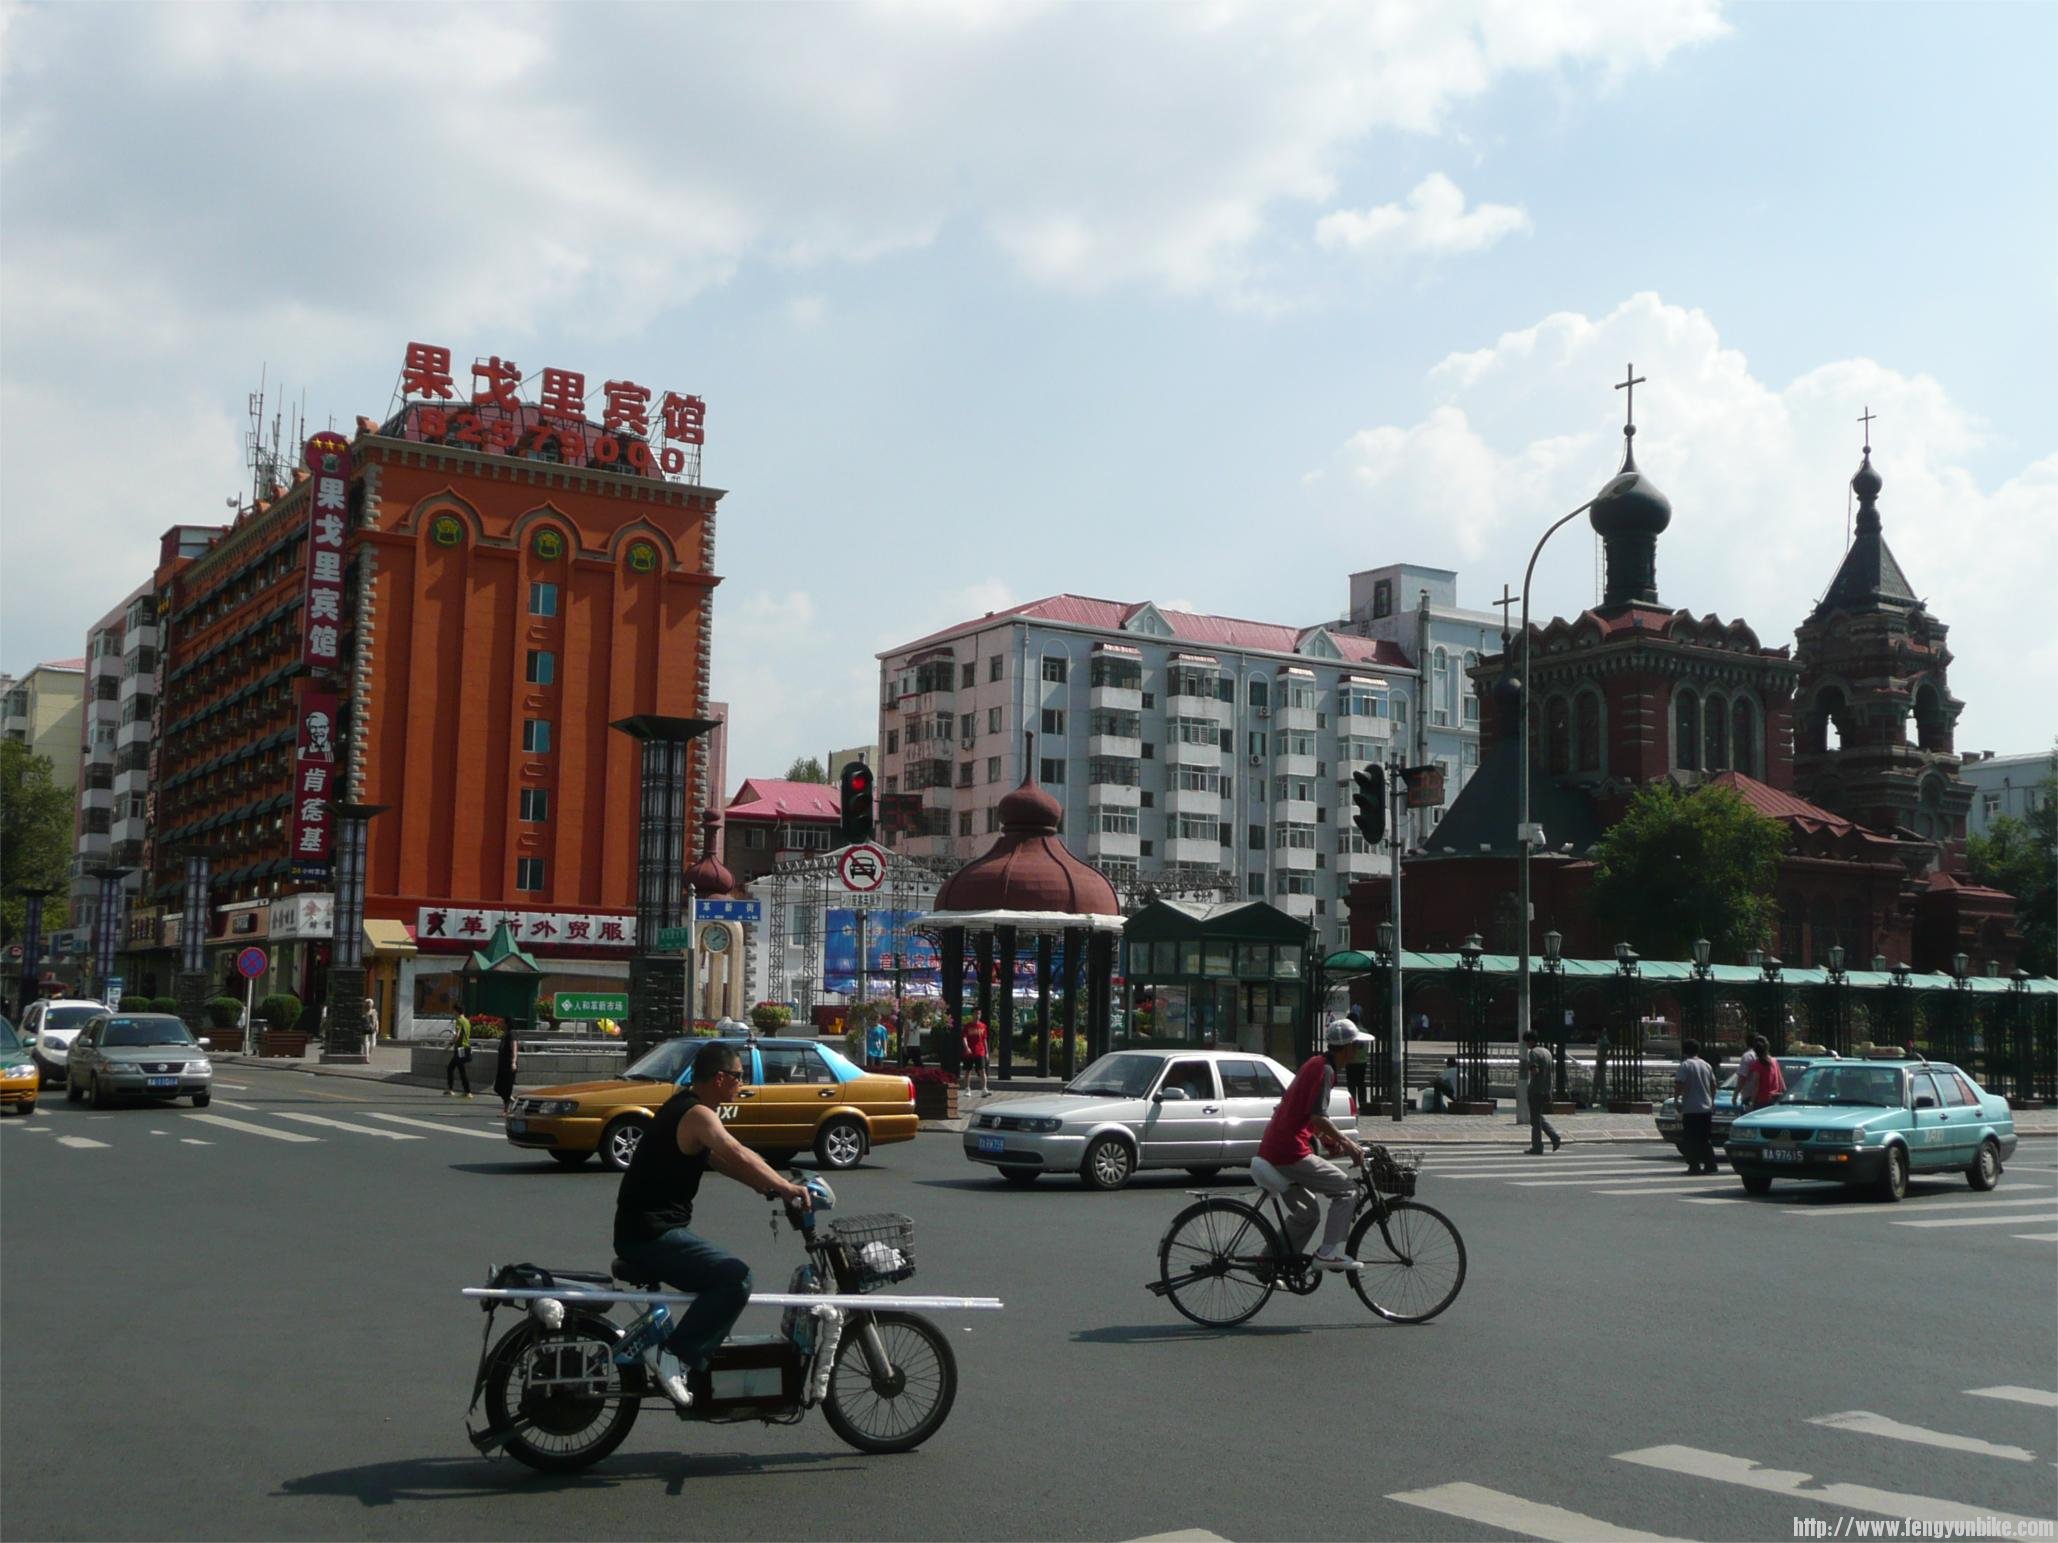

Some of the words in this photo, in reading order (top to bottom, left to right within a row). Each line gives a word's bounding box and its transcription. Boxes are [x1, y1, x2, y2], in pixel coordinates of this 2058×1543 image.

[402, 341, 706, 446] 果戈里宾馆
[420, 408, 686, 474] 82579000
[310, 477, 346, 659] 果戈里宾馆
[299, 766, 327, 853] 肯德基
